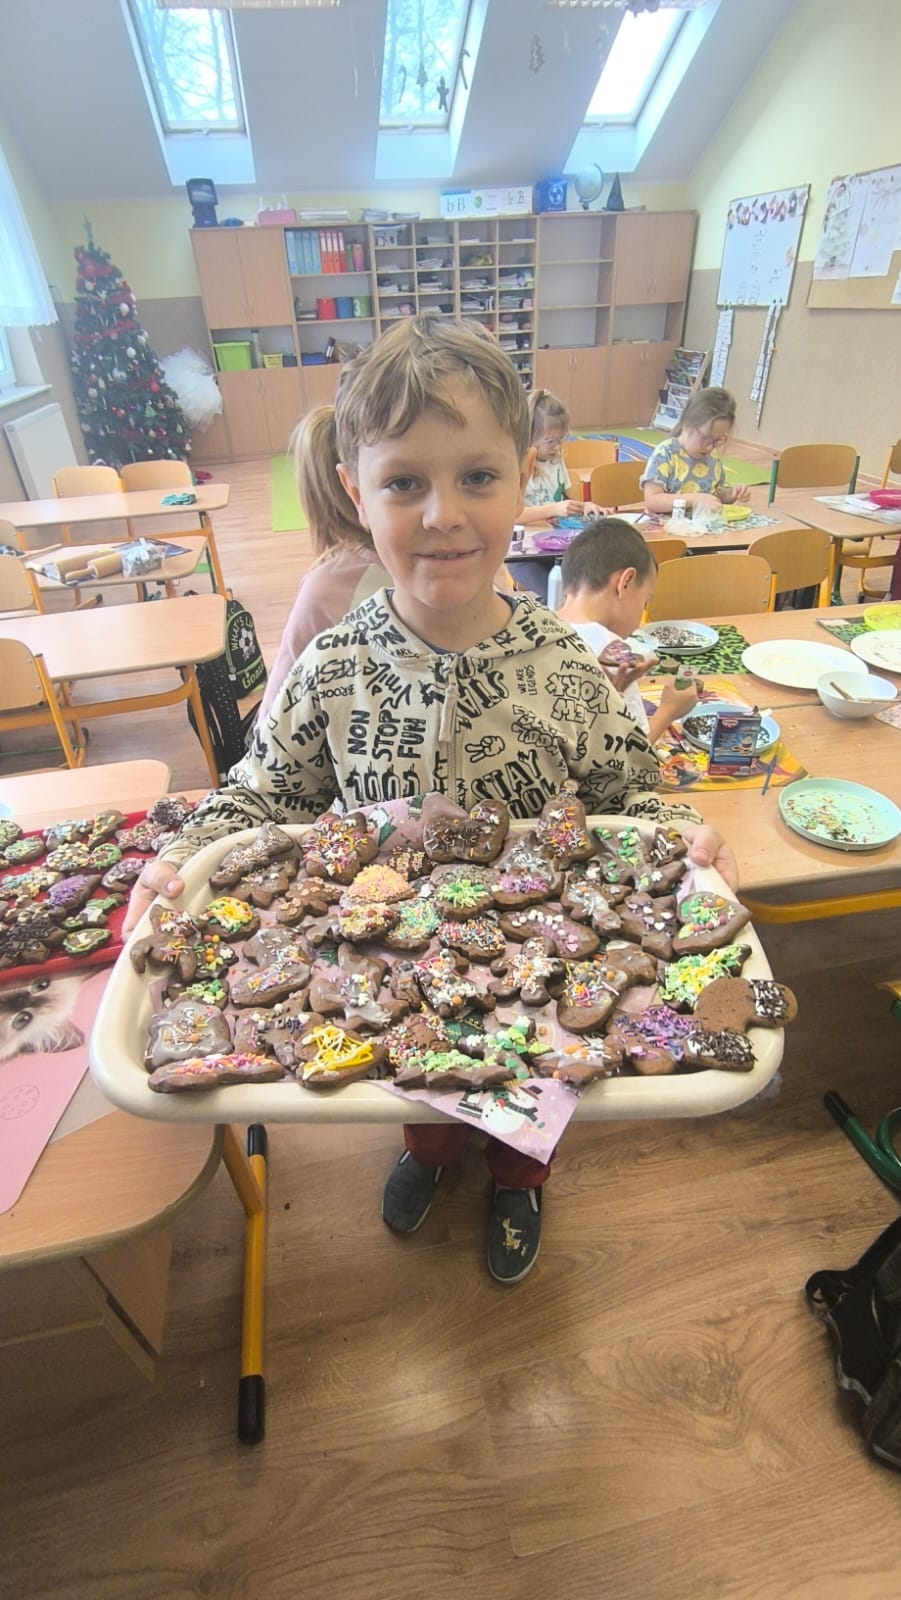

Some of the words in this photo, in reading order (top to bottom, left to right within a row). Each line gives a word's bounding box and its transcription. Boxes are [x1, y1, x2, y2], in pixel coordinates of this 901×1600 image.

[545, 672, 610, 714] YORK
[347, 710, 370, 755] NON
[372, 709, 401, 762] STOP
[397, 717, 427, 759] FUN
[471, 749, 542, 801] STAY
